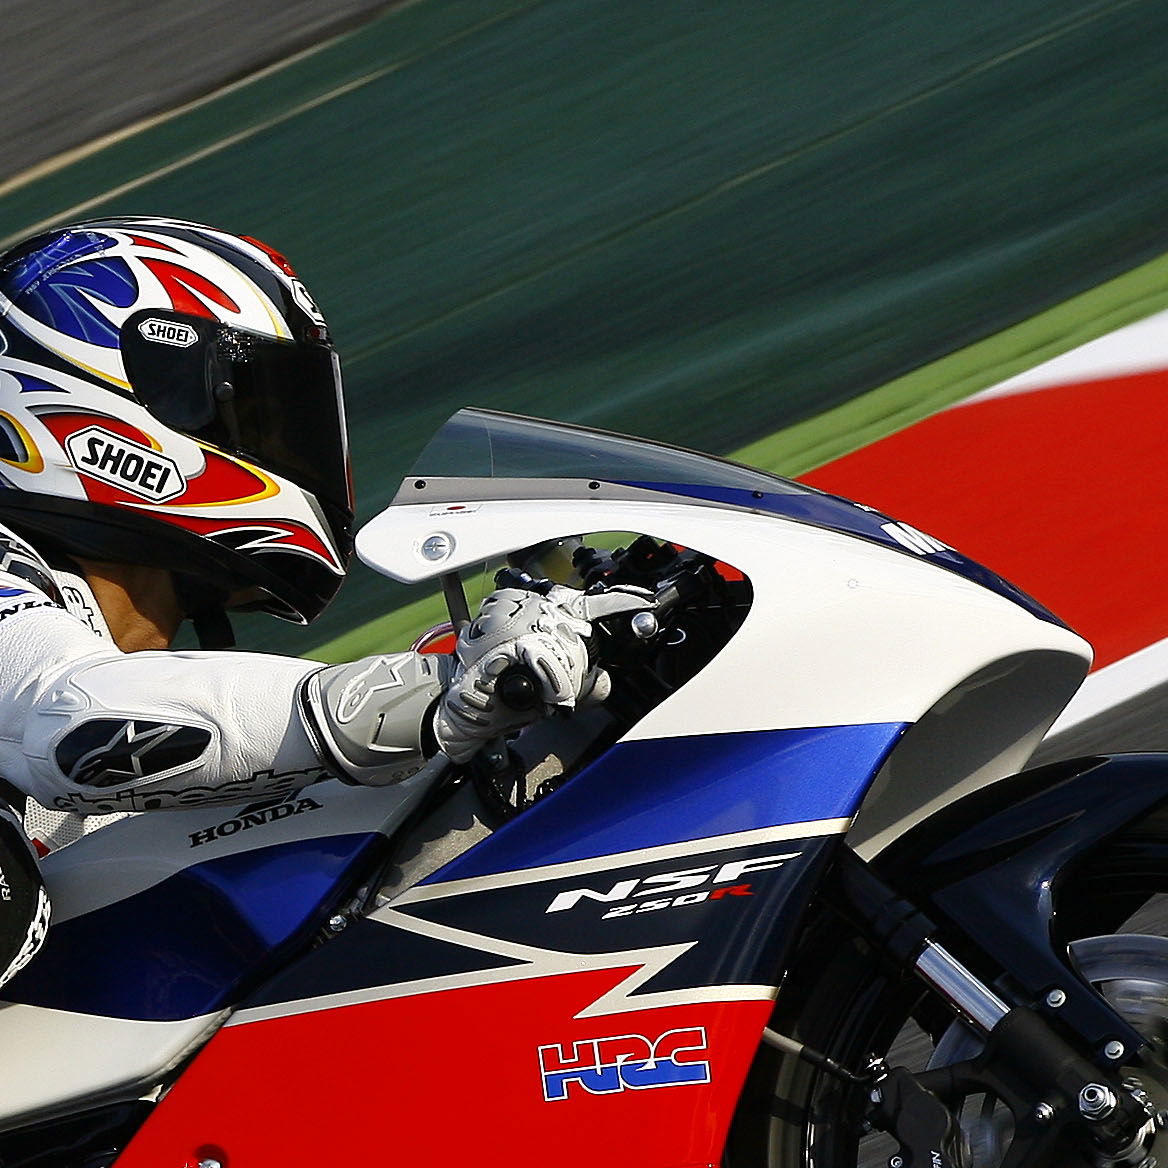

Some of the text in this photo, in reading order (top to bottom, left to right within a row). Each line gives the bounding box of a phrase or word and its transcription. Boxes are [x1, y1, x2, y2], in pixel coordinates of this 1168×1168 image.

[147, 323, 189, 342] SHOEI
[81, 437, 172, 494] SHOEI
[188, 798, 324, 848] HONDA
[545, 852, 803, 914] NSF
[601, 883, 755, 920] 250R
[538, 1026, 711, 1101] HRC
